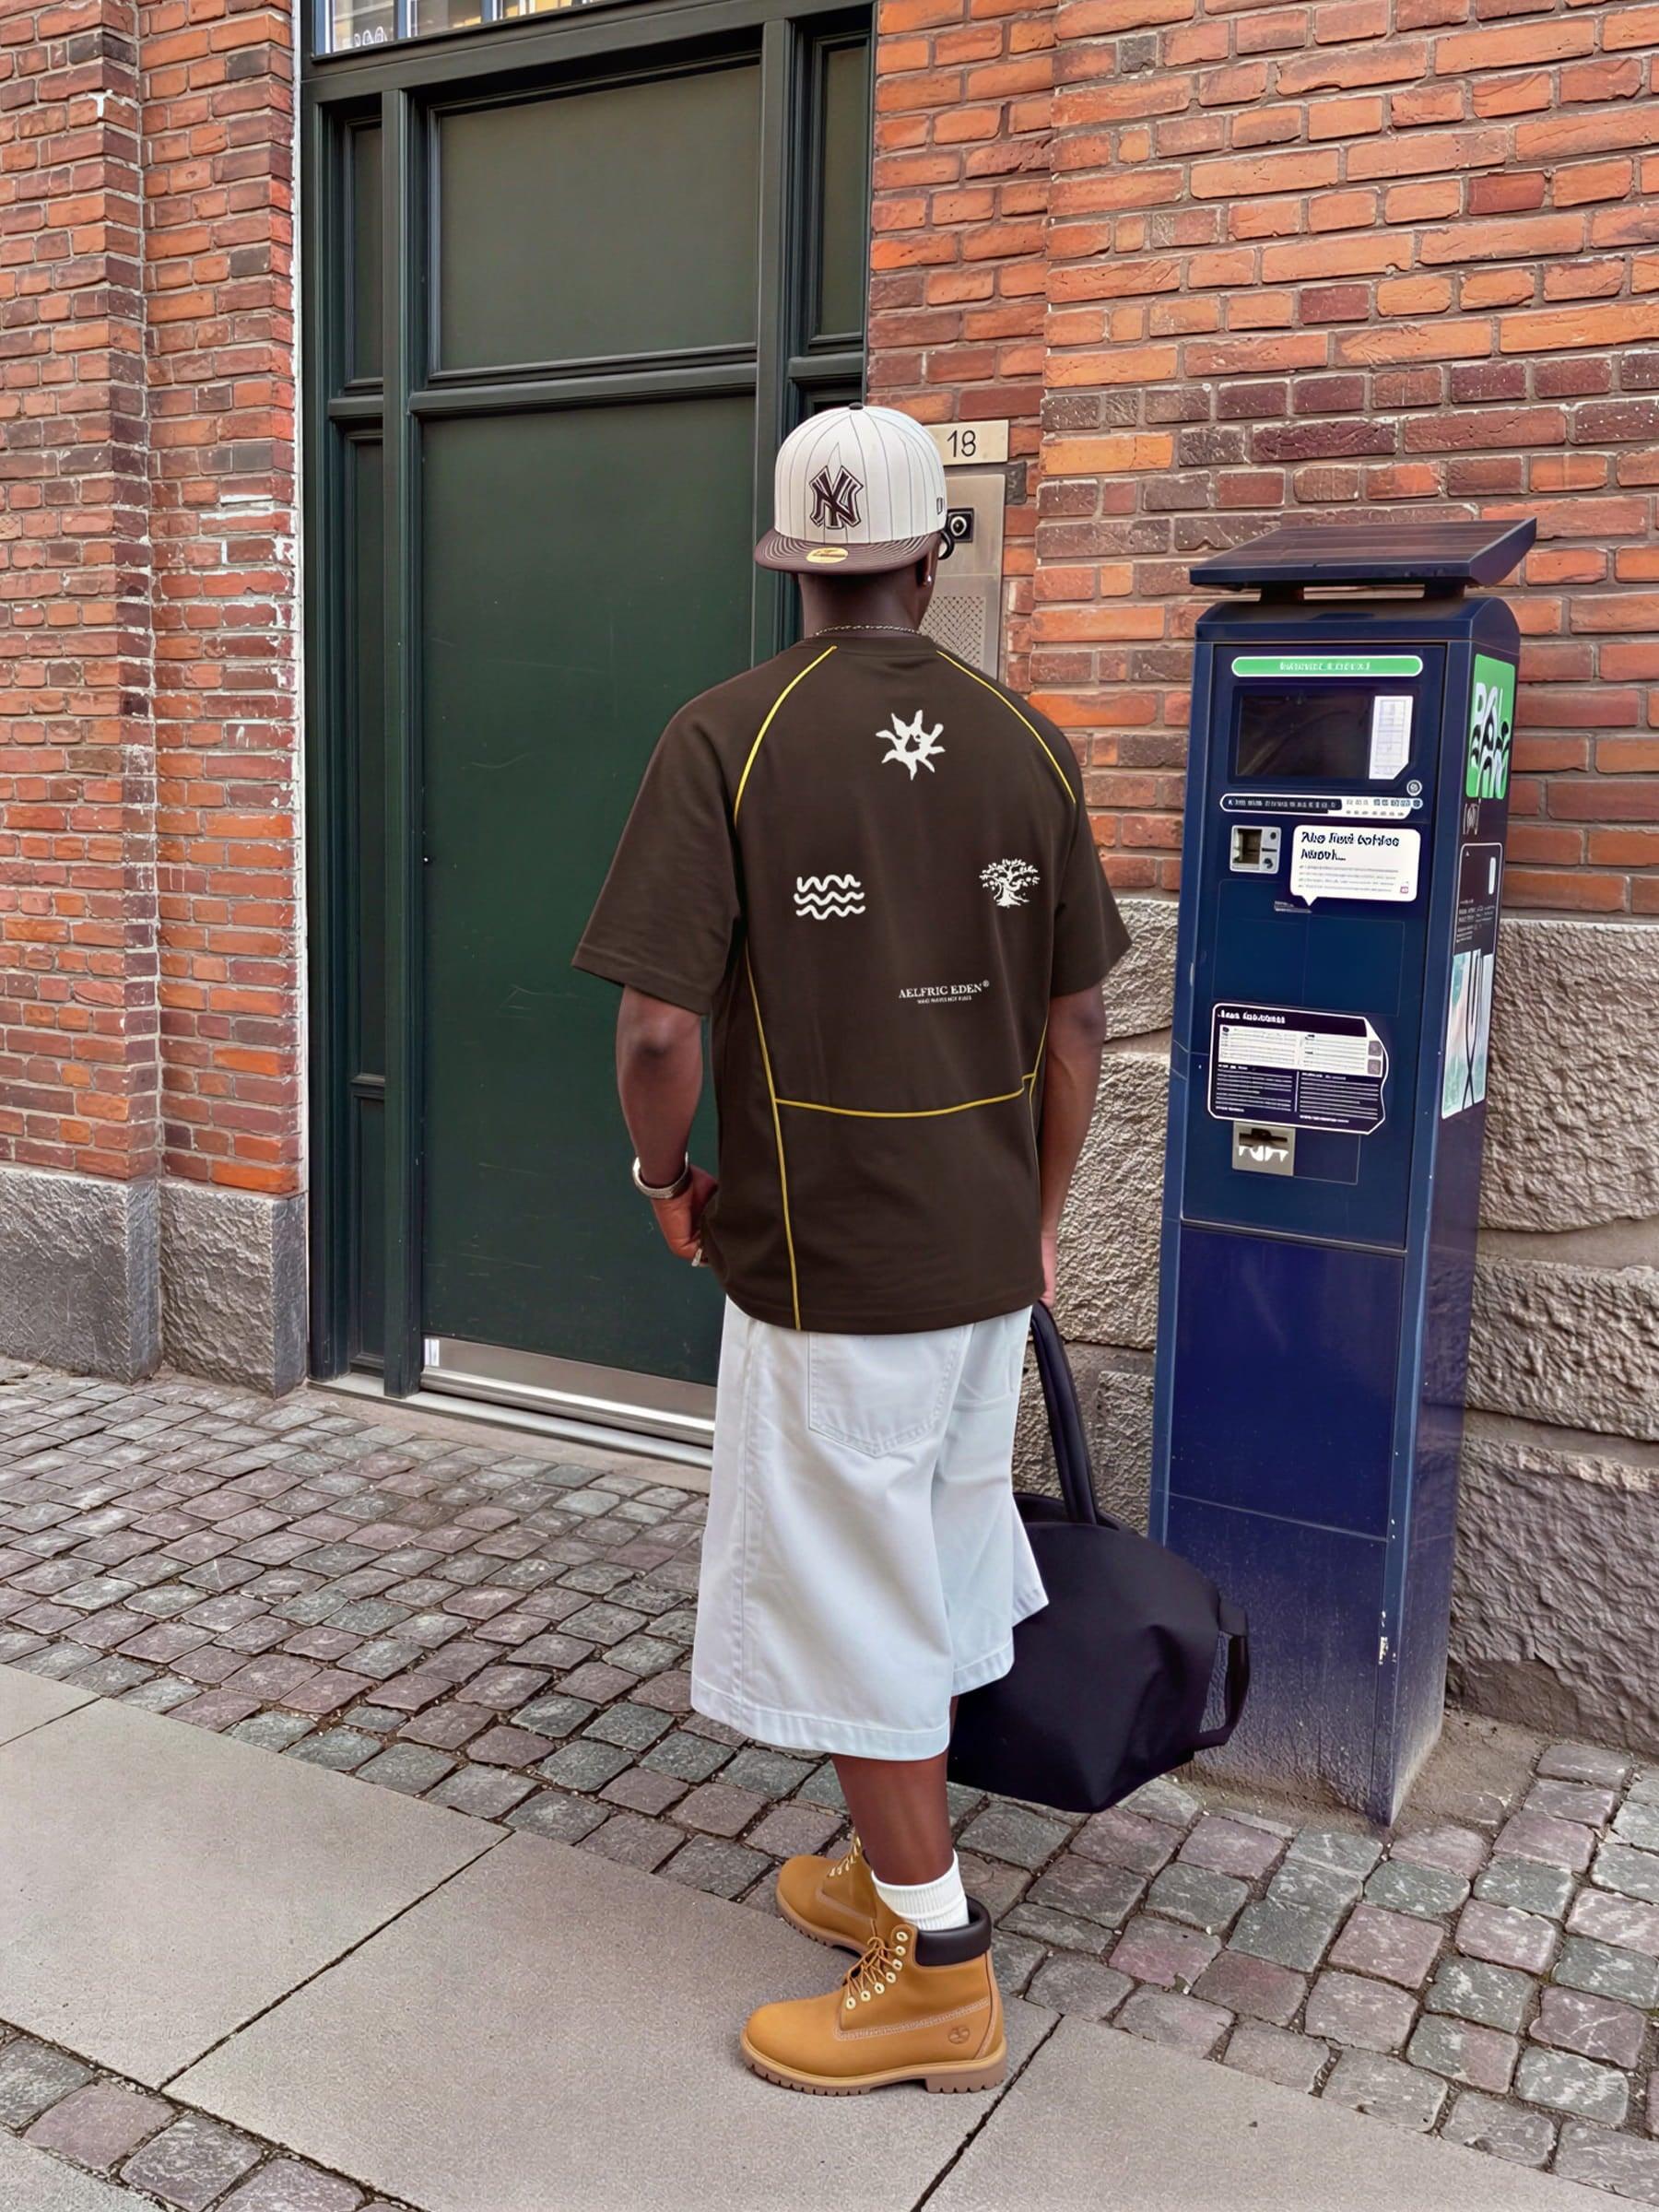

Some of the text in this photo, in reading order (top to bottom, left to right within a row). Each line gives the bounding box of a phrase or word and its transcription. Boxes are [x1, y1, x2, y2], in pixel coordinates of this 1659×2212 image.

[947, 429, 976, 457] 18
[809, 465, 864, 530] NY
[899, 985, 948, 998] AELFRIC
